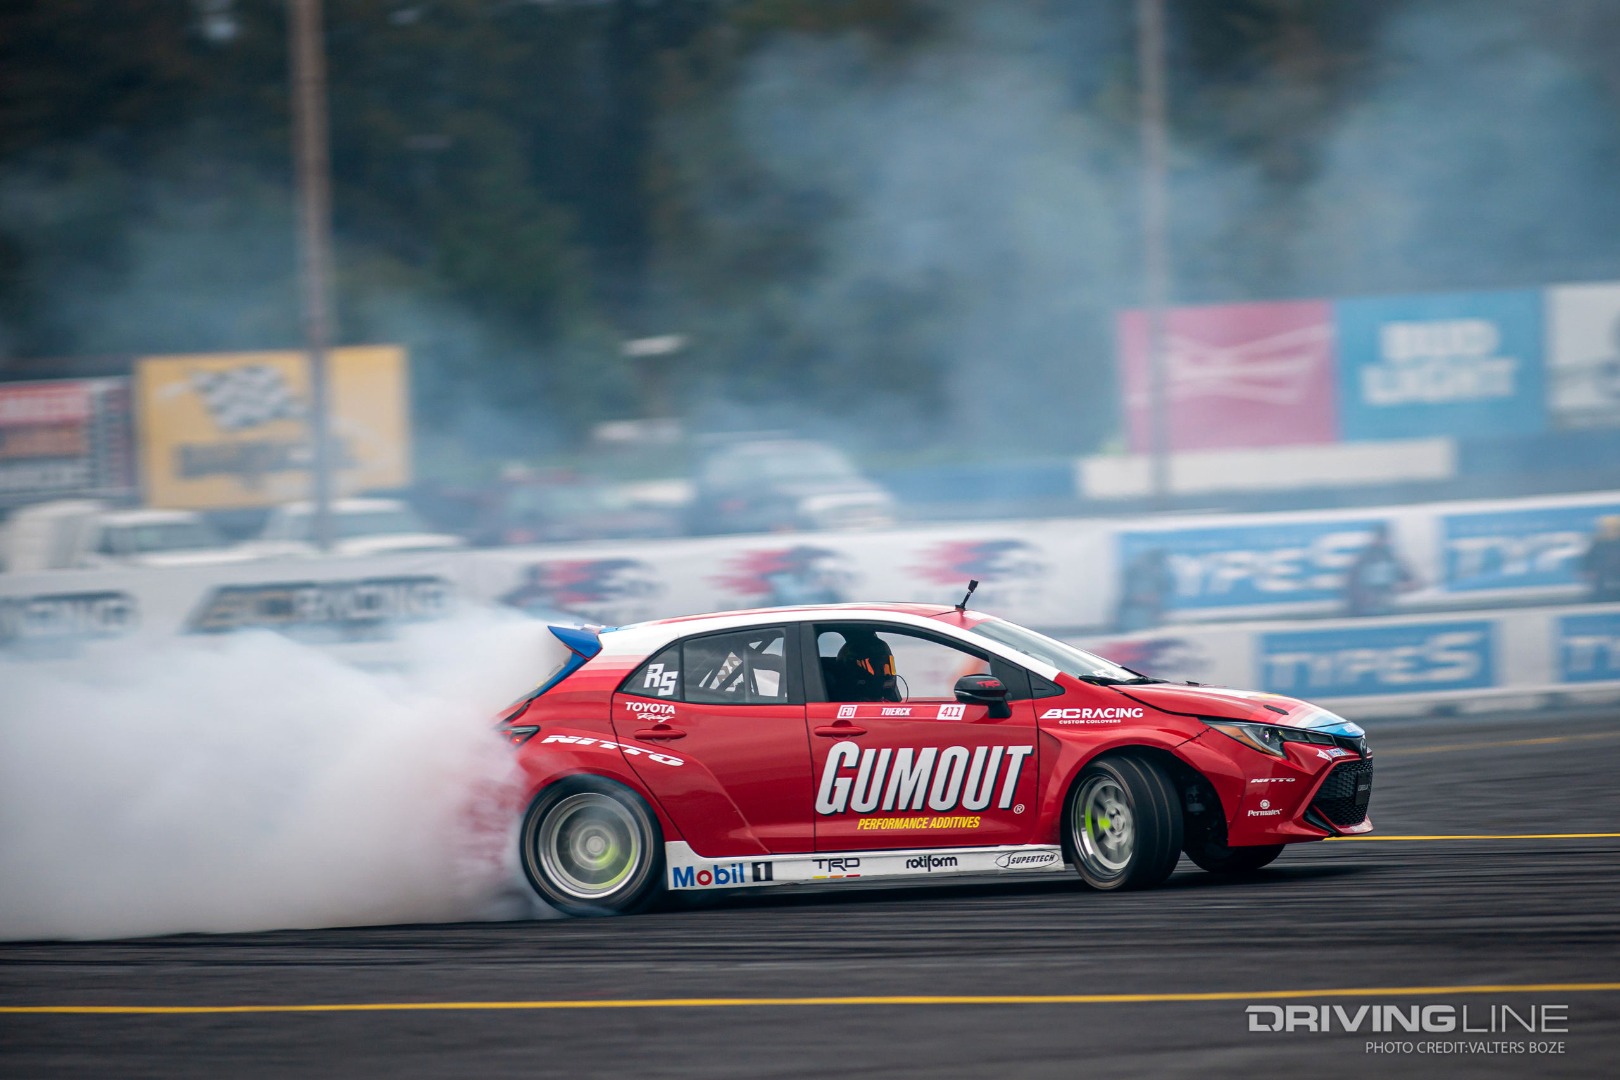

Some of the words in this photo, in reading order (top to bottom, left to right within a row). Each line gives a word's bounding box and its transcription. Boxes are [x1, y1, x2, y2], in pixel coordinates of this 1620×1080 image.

[1165, 531, 1373, 597] YPES
[1445, 530, 1592, 582] TYP
[643, 663, 678, 696] RS
[625, 701, 676, 714] TOYOTA
[881, 707, 912, 716] TUERCK
[940, 706, 962, 718] 411
[541, 735, 685, 767] NITTO
[814, 740, 1034, 816] GUMOUT
[857, 817, 929, 830] PERFORMANCE
[929, 816, 981, 829] ADDITIVES
[812, 857, 860, 873] TRD
[905, 855, 958, 872] rotiform
[1009, 854, 1056, 865] SUPERTECH
[672, 862, 745, 888] Mobil
